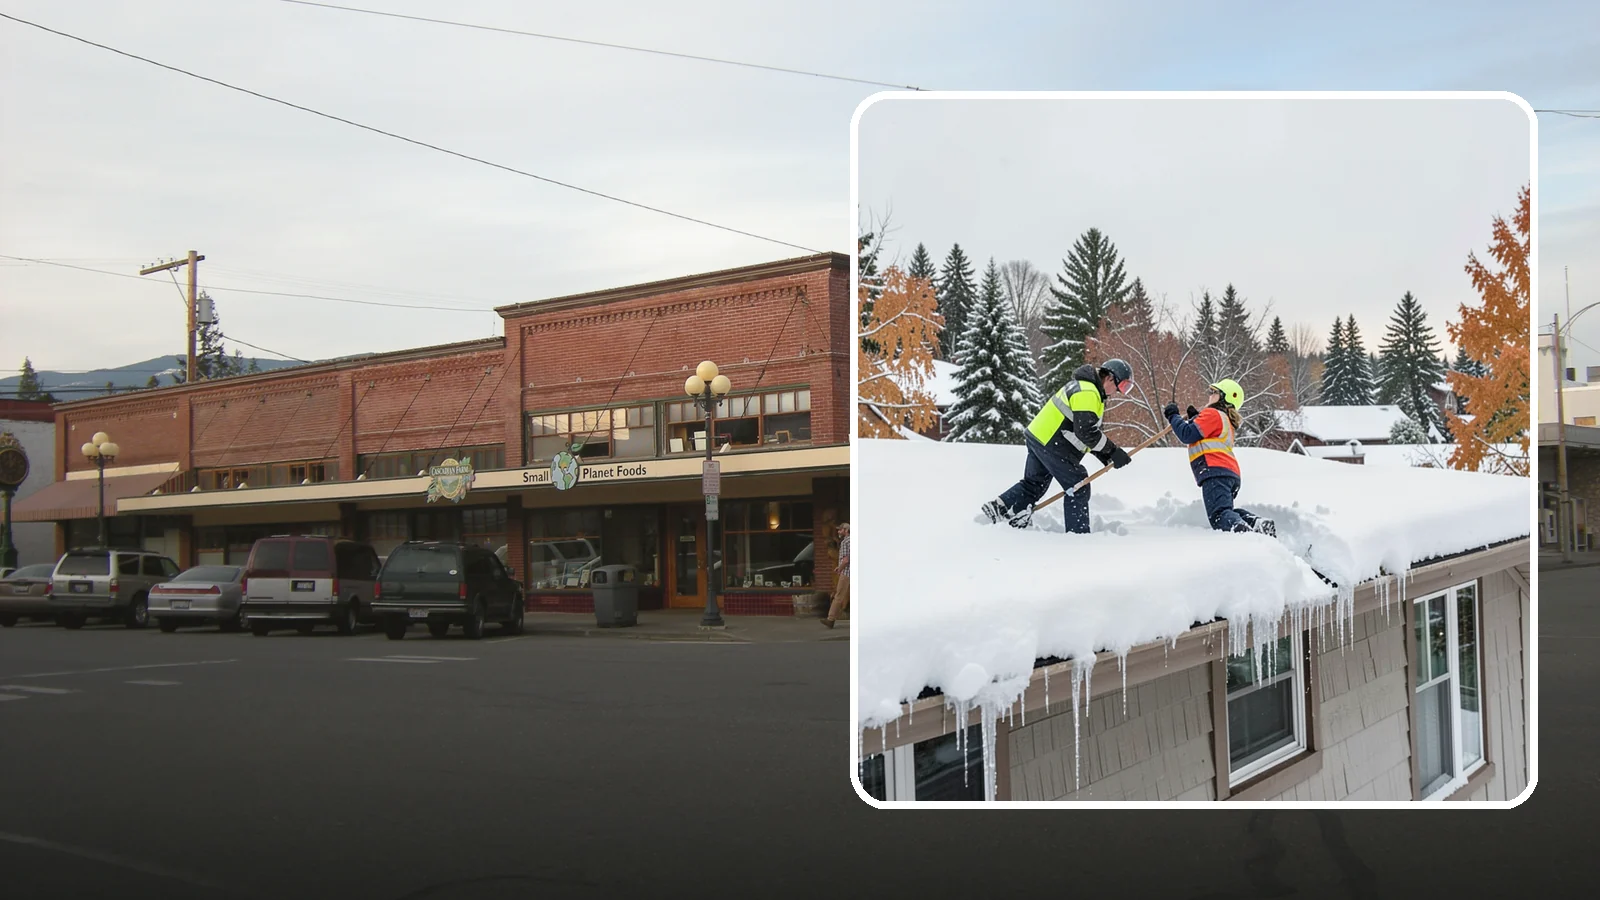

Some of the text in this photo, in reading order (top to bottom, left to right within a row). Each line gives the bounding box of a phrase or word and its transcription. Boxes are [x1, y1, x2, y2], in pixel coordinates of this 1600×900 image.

[523, 464, 647, 482] Small Planet Foods
